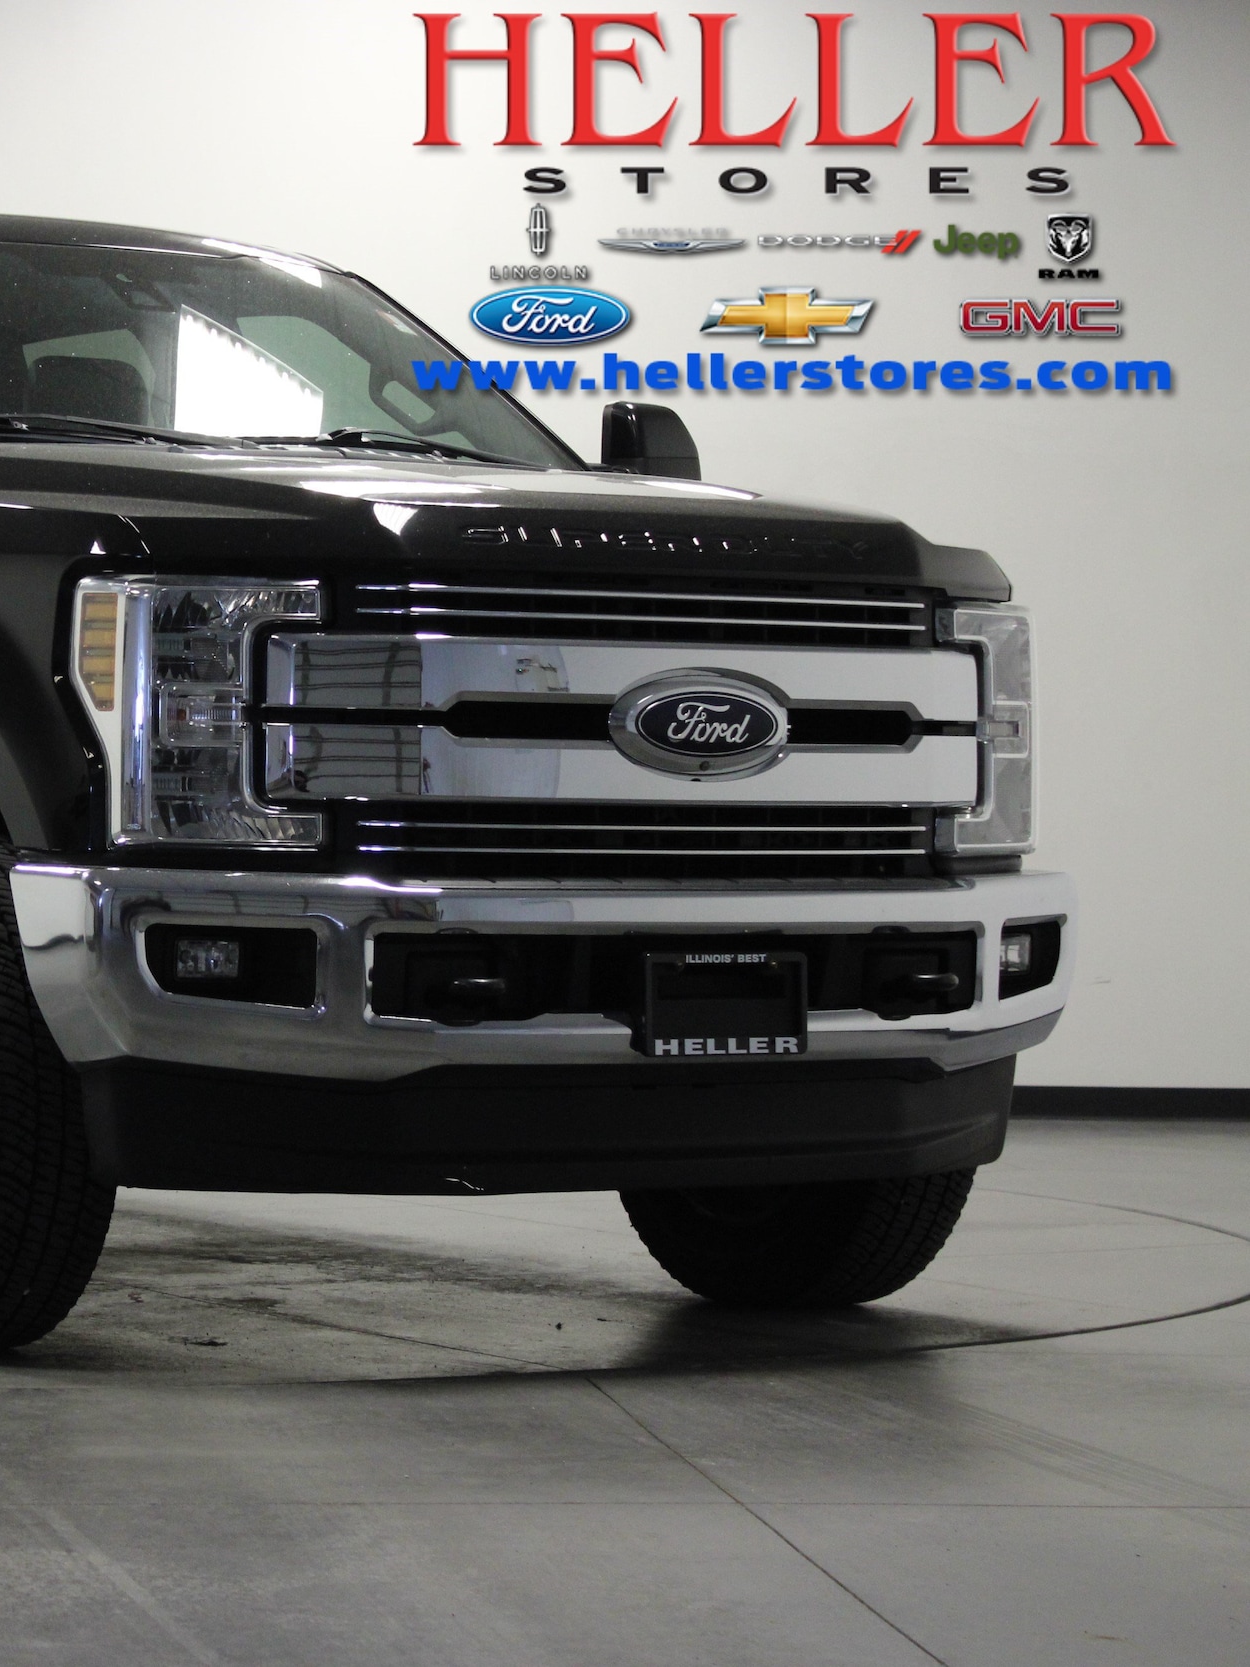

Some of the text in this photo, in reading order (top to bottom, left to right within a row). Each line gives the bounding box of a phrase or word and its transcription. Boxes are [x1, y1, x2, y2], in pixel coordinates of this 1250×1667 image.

[666, 701, 751, 744] Ford
[737, 953, 767, 963] BEST
[654, 1036, 799, 1056] HELLER
